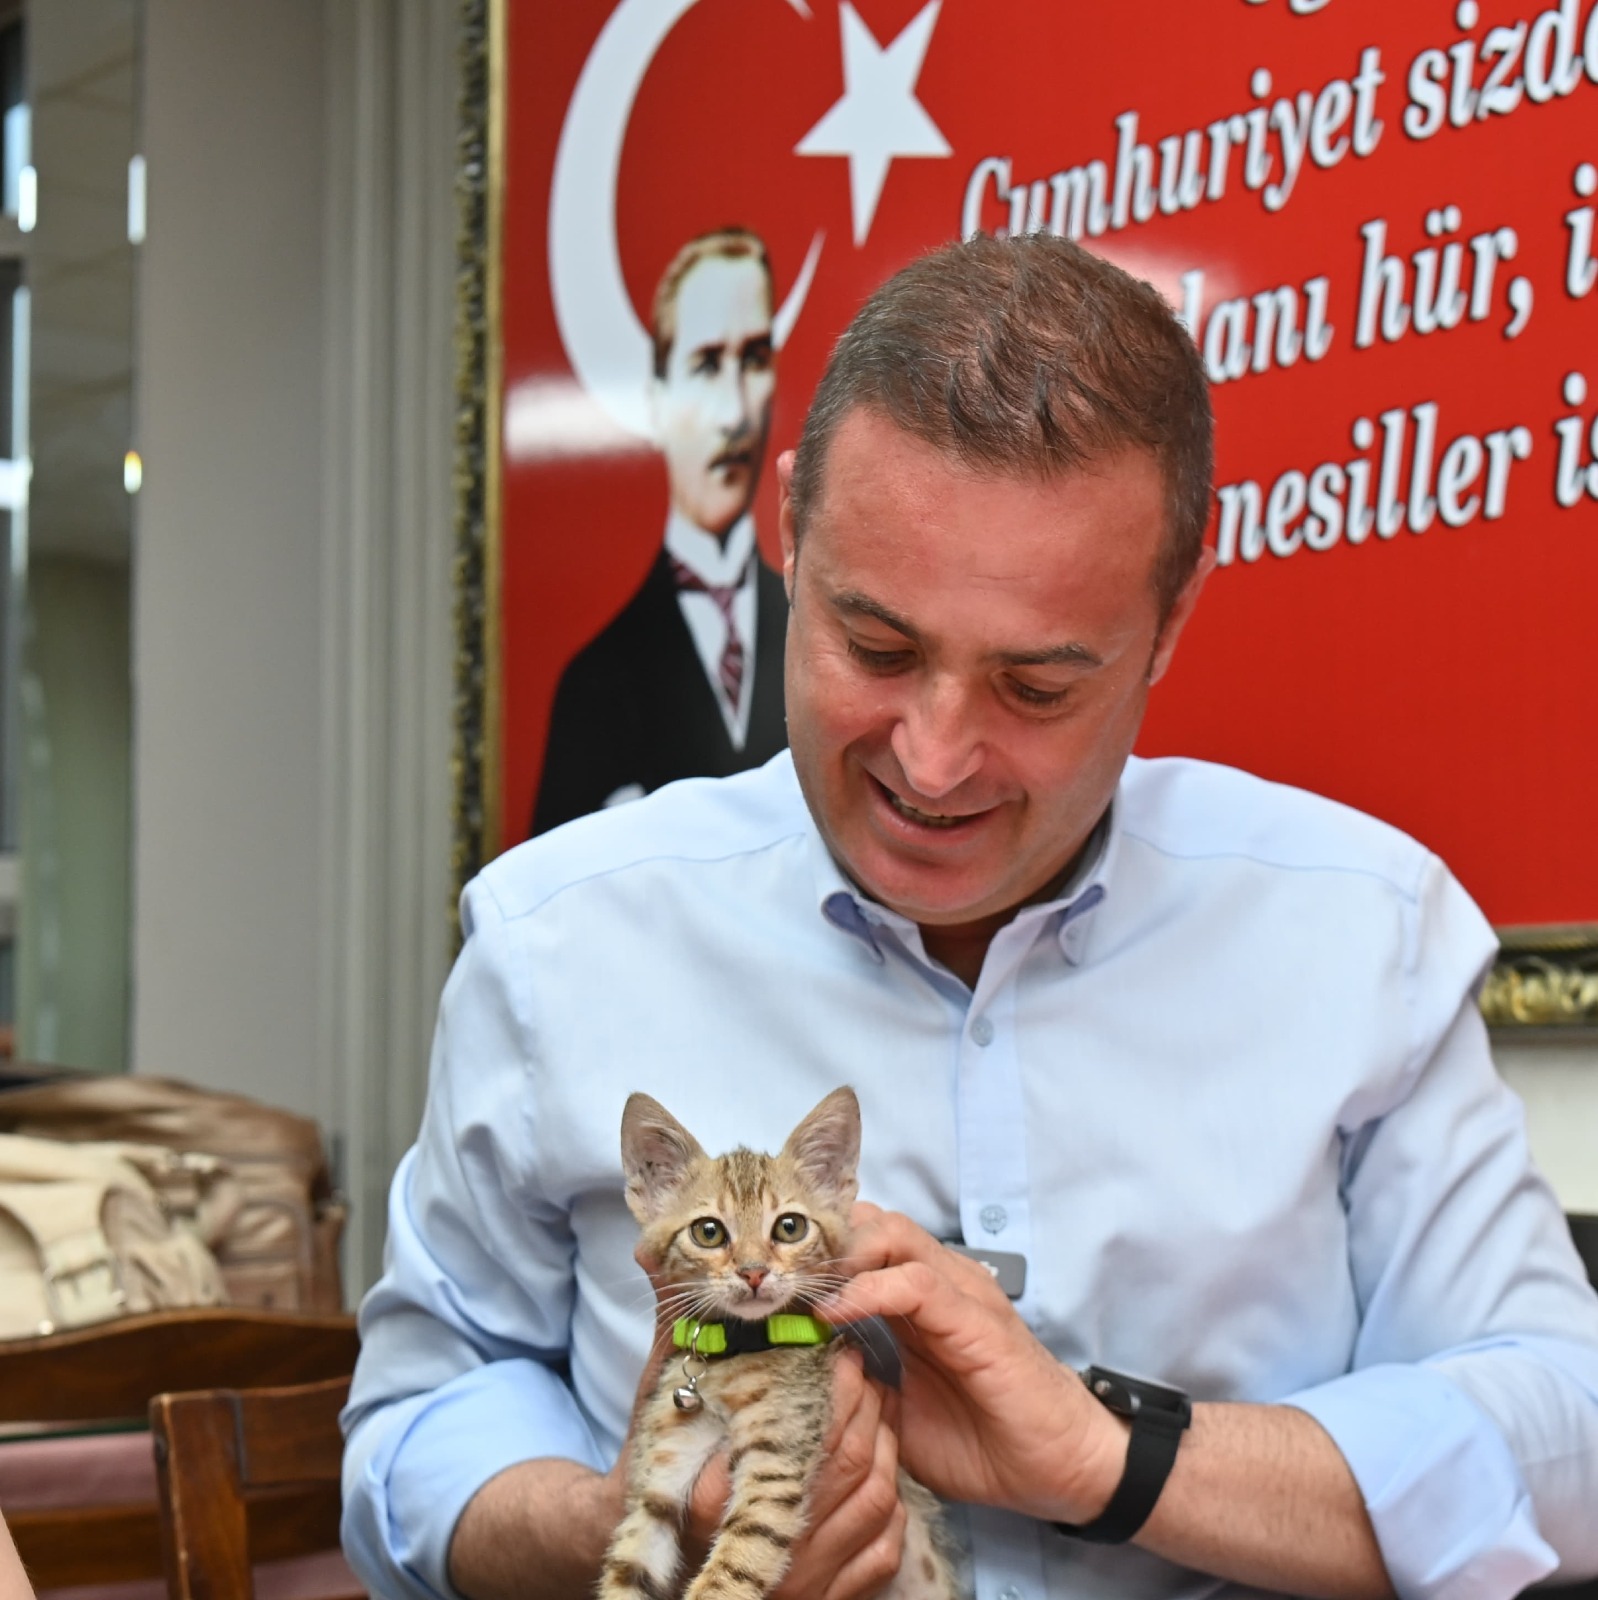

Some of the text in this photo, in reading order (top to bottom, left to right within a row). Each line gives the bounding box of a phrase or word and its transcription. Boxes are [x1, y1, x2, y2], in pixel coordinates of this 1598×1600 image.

[961, 46, 1386, 244] Cumhuriyet
[1355, 204, 1534, 348] hür,
[1216, 401, 1533, 566] nesiller
